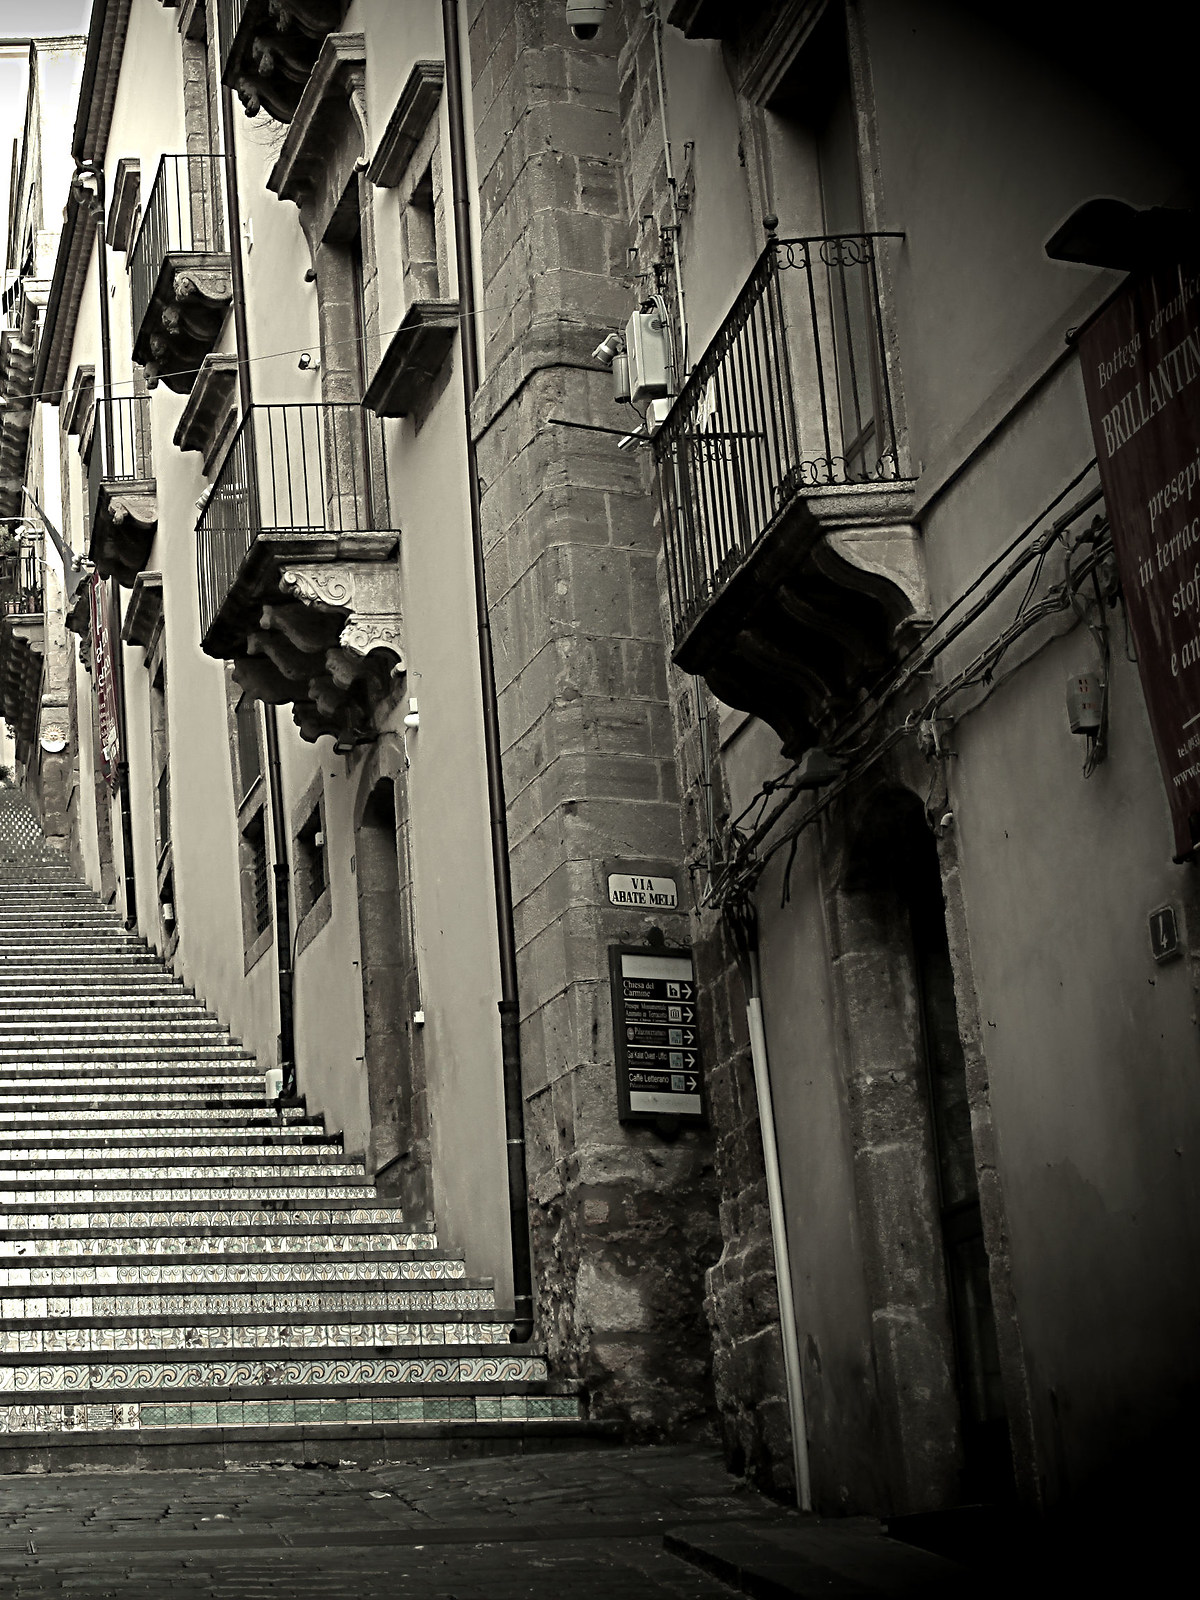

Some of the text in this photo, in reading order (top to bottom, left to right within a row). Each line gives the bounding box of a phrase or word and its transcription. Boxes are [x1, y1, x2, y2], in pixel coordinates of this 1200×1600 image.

[1097, 332, 1142, 390] Bottega
[1138, 516, 1200, 587] in terrac
[1170, 652, 1179, 678] e
[631, 878, 654, 891] VIA
[612, 890, 675, 906] ABATE MELI
[623, 979, 654, 990] Chiesa del
[623, 988, 651, 997] Carmine
